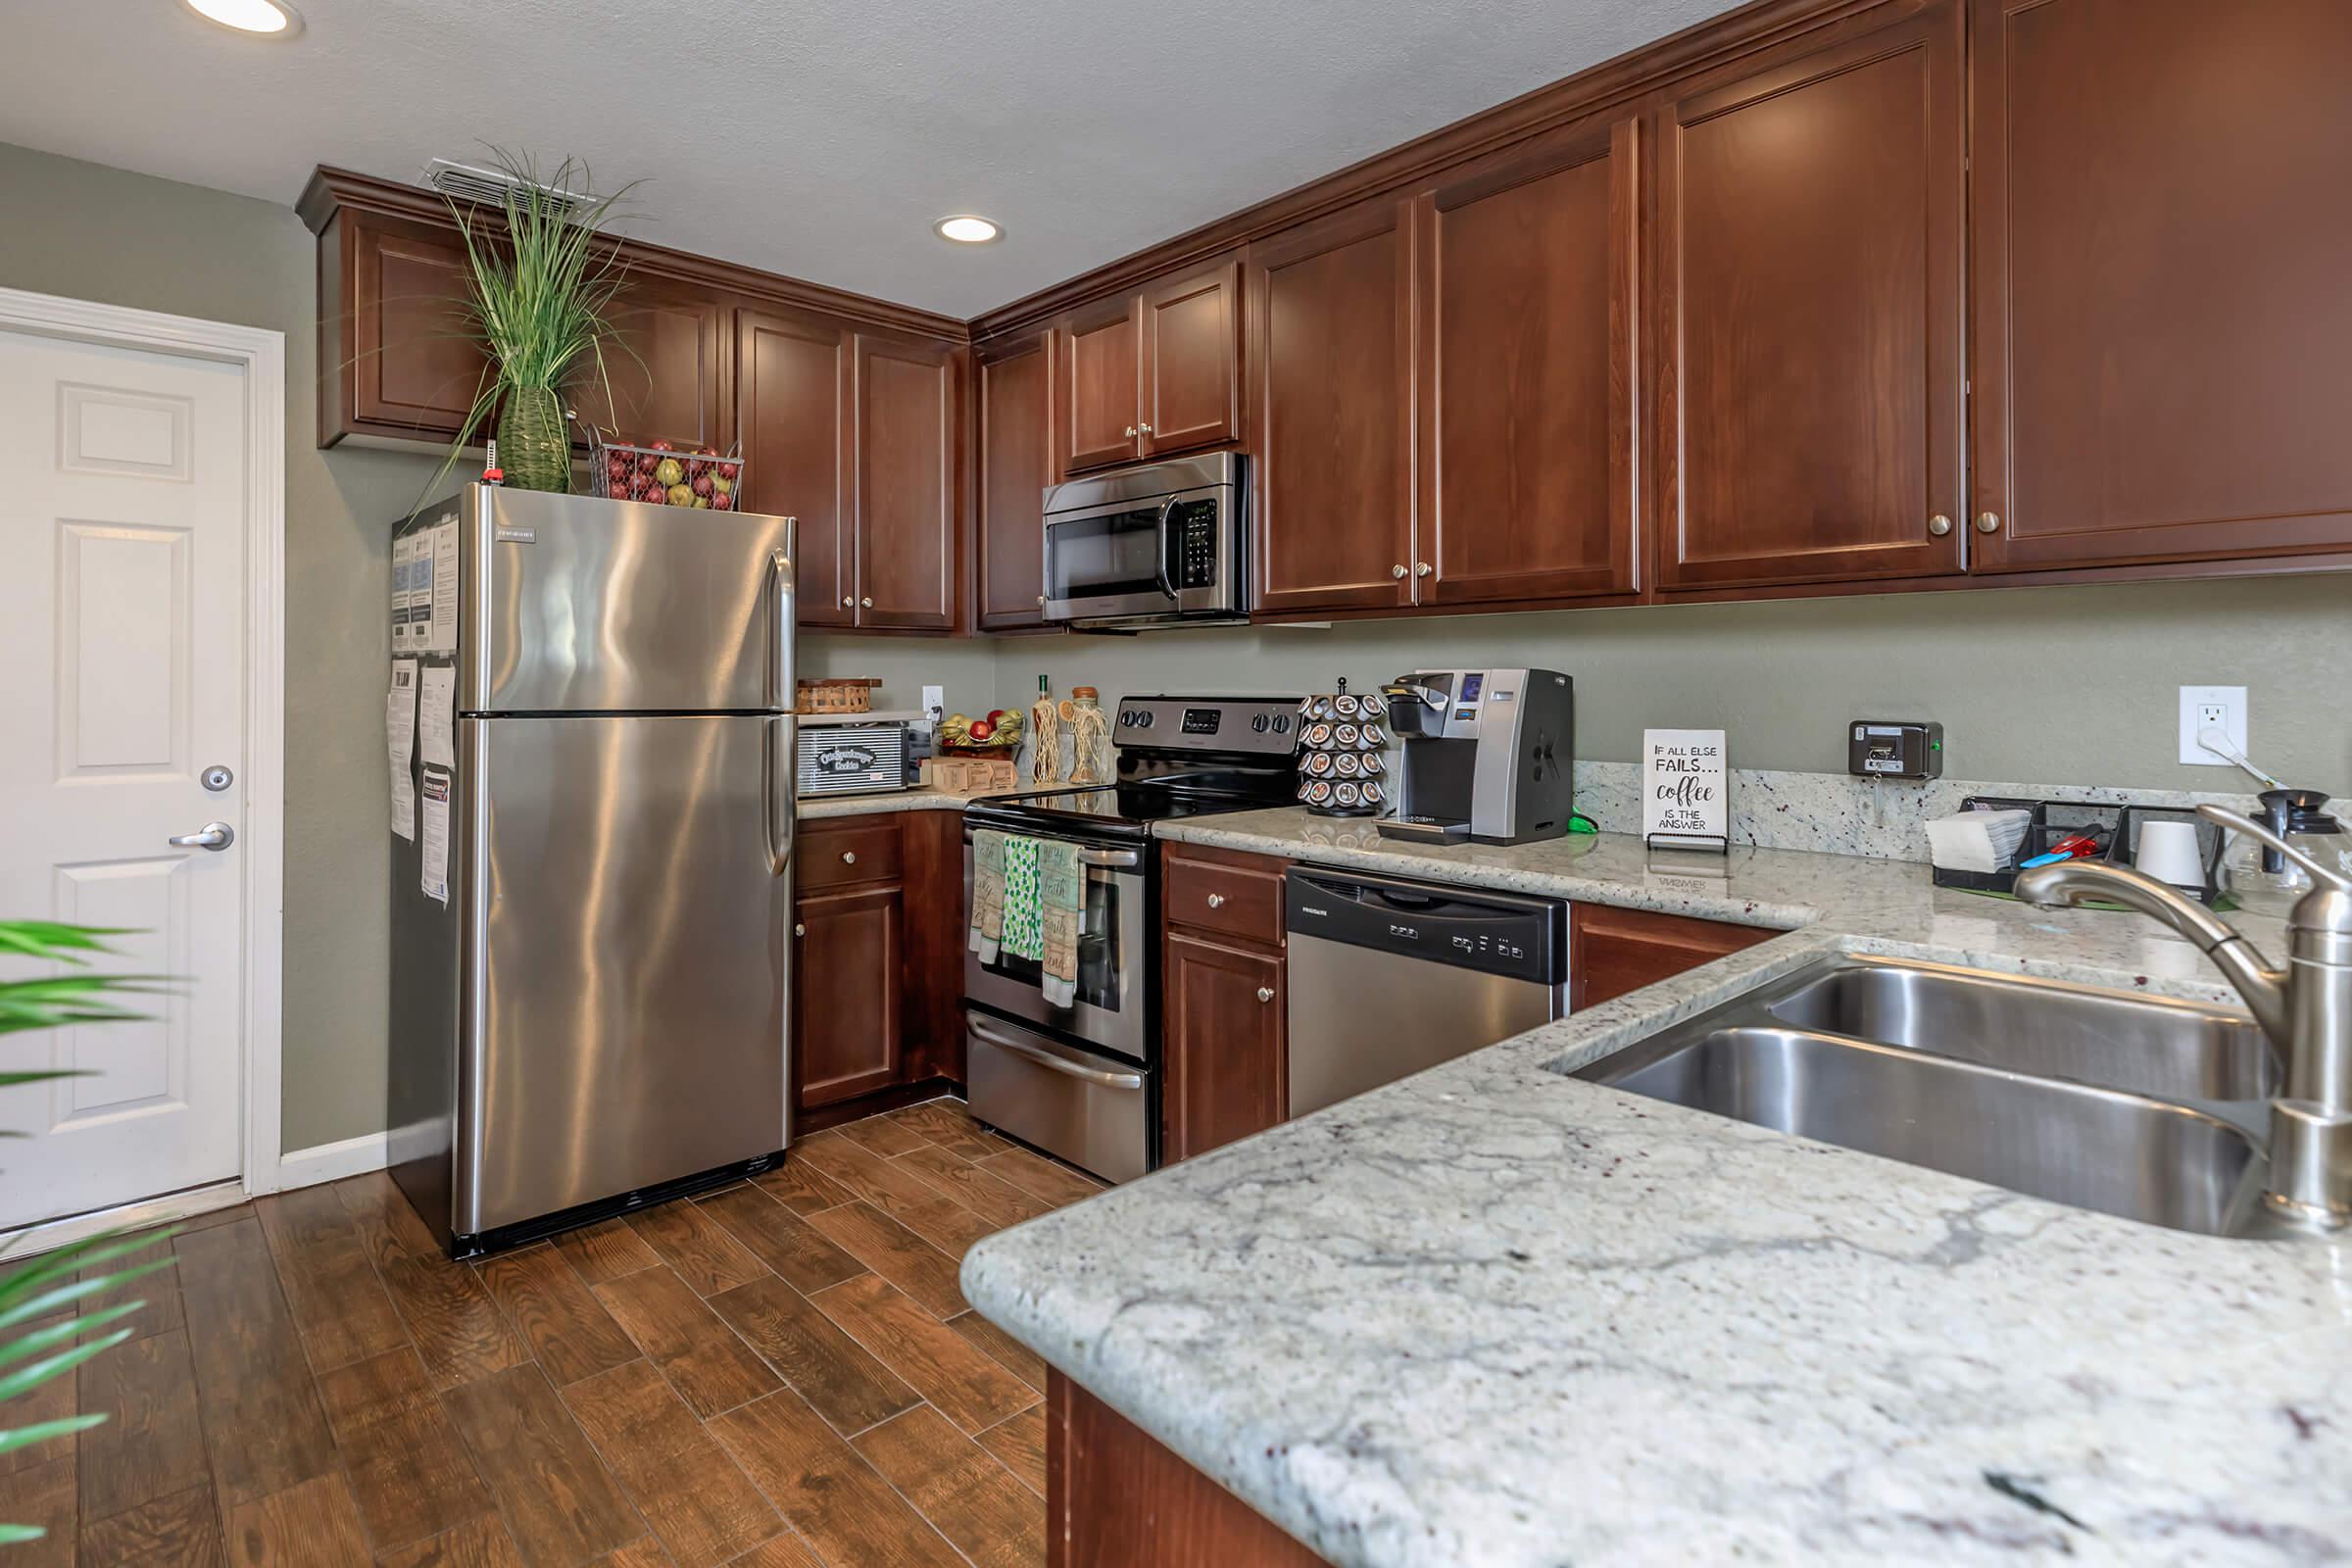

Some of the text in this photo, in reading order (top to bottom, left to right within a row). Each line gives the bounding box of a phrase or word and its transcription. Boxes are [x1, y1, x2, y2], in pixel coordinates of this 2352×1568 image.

[1668, 747, 1687, 756] ALL
[1690, 747, 1717, 756] ELSE
[1655, 759, 1718, 773] FAILS...
[1656, 775, 1714, 807] coffee
[1664, 809, 1700, 819] IS THE
[1658, 819, 1706, 830] ANSWER
